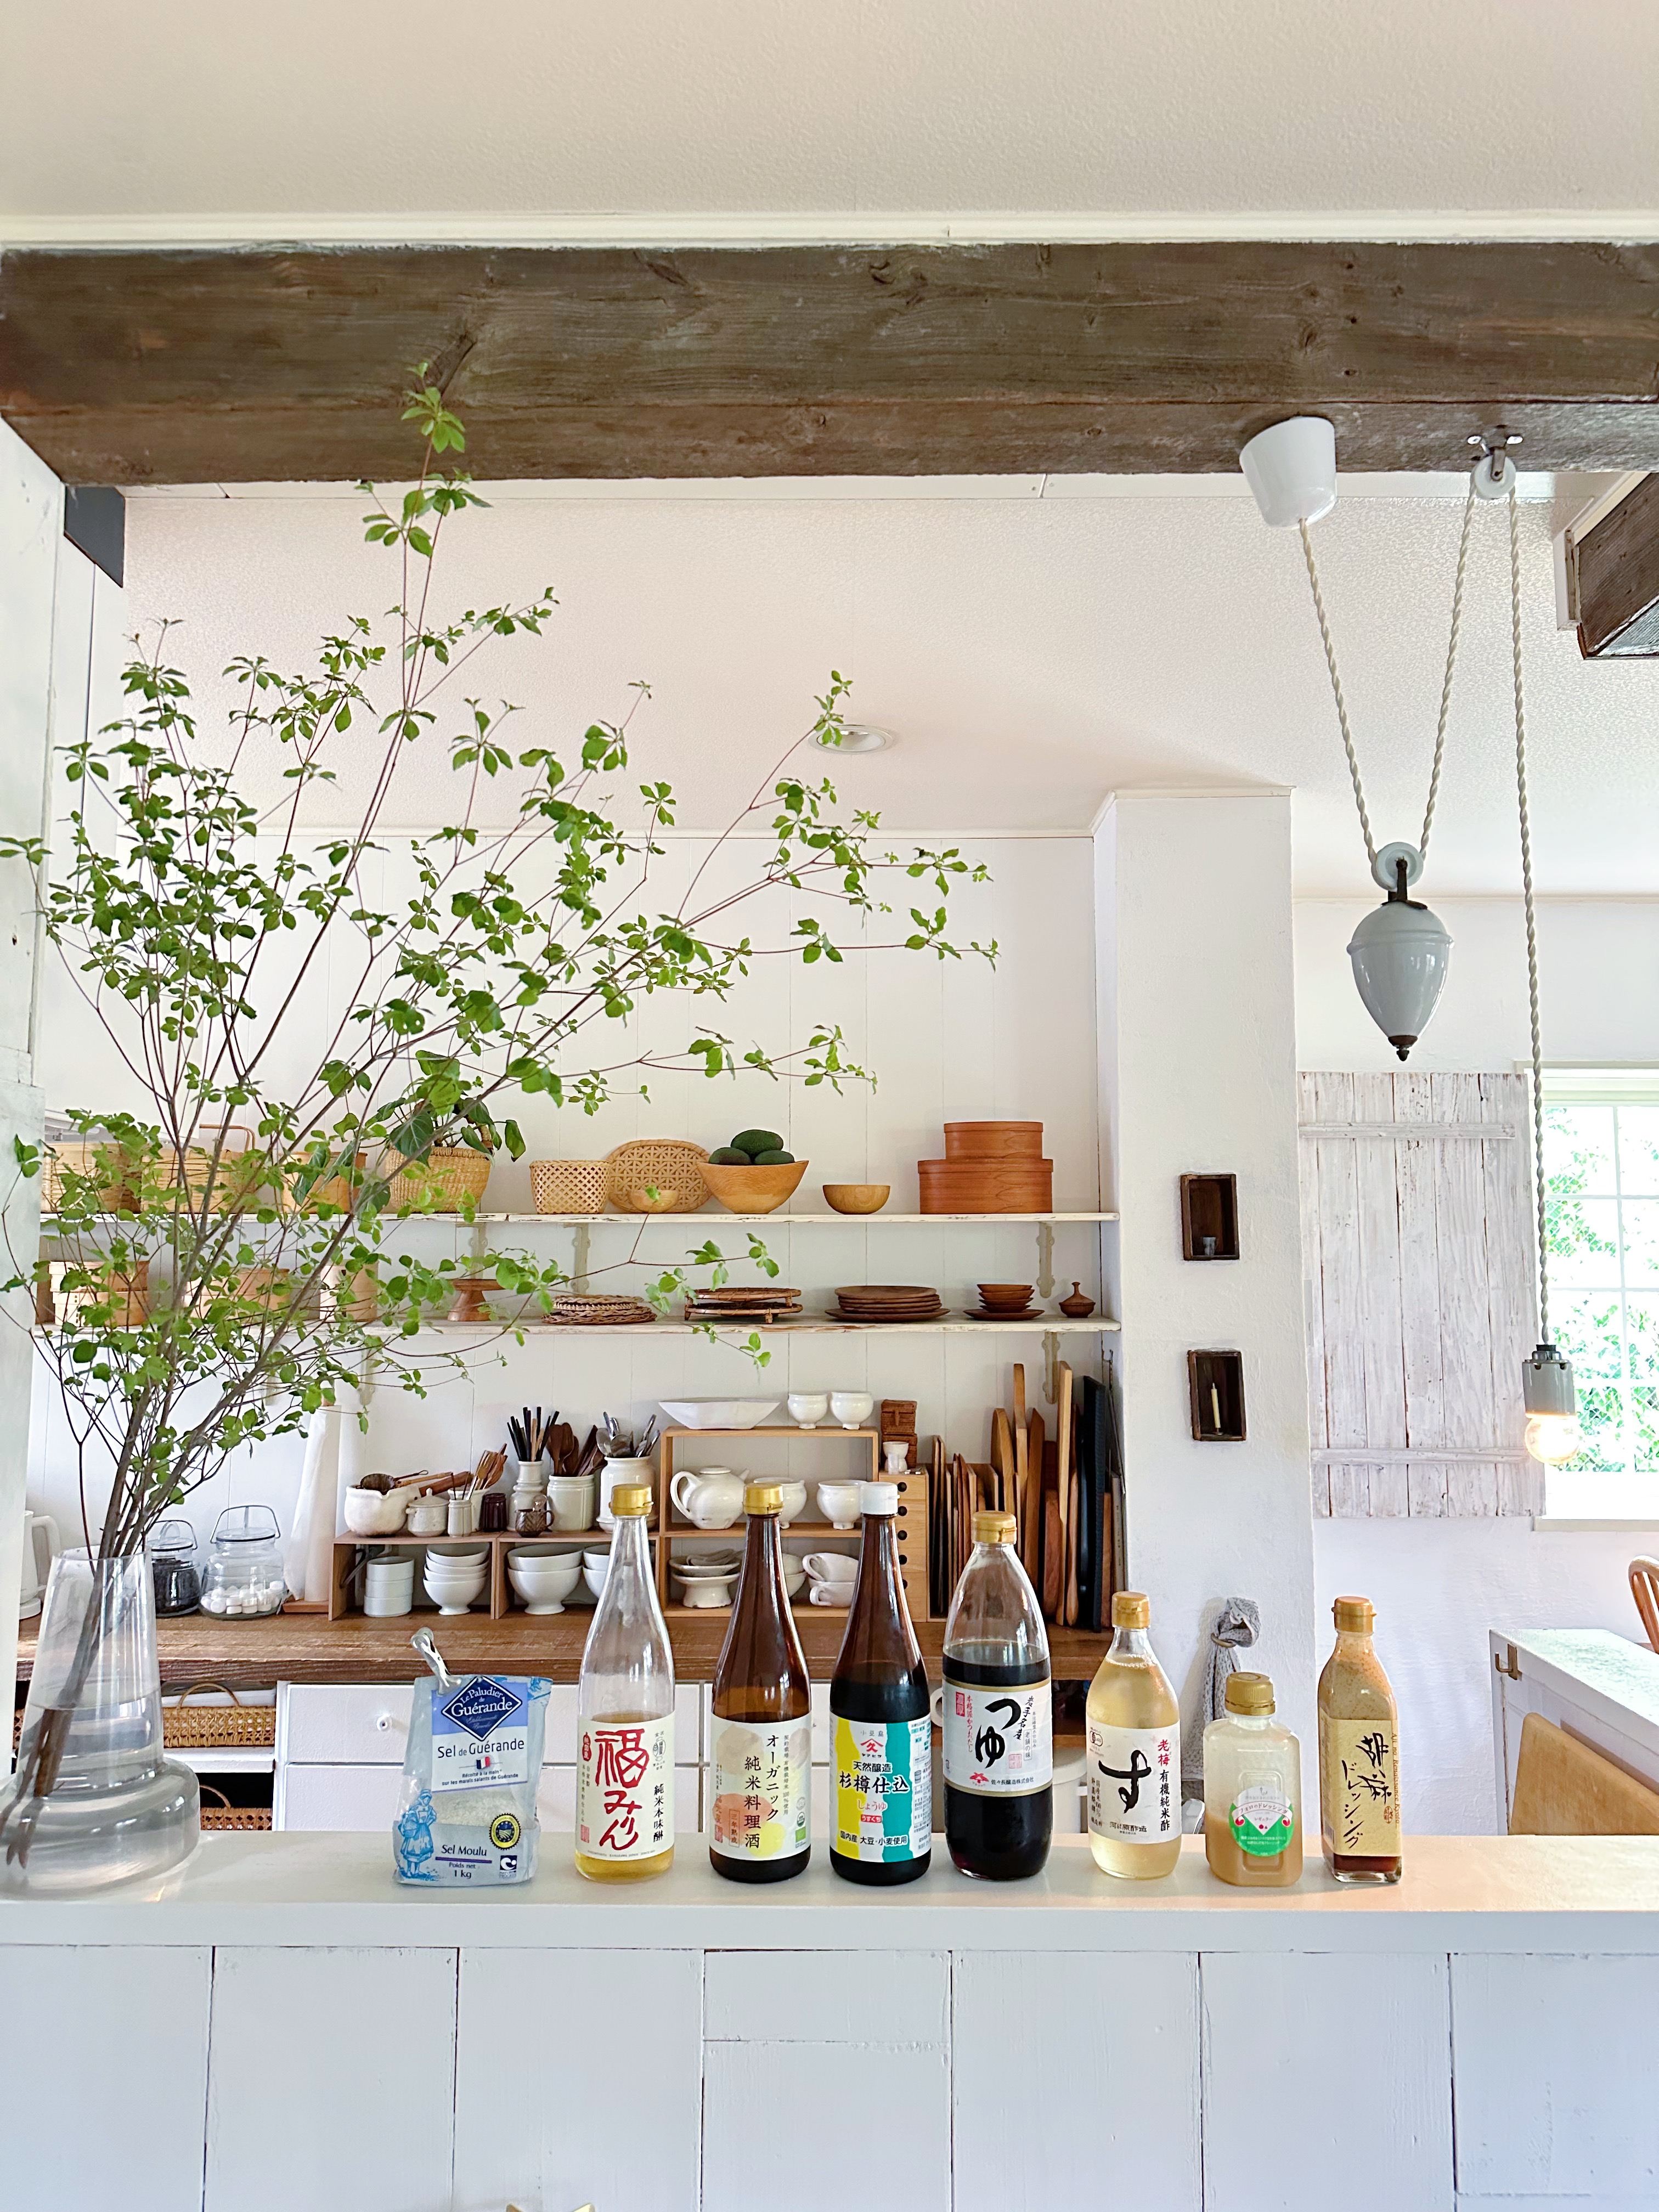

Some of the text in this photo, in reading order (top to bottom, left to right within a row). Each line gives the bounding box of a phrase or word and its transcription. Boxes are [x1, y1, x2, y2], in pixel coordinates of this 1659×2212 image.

[468, 1686, 504, 1699] Paludier
[451, 1696, 513, 1717] Guérande
[1013, 1696, 1034, 1740] 岩手名産
[975, 1698, 1021, 1769] つゆ
[438, 1745, 456, 1758] Sel
[469, 1738, 524, 1754] Guérande
[766, 1735, 781, 1821] オーガニック
[853, 1760, 891, 1773] 天然醸造
[1356, 1733, 1392, 1805] 胡麻
[839, 1771, 909, 1794] 杉樽仕込
[991, 1777, 1034, 1785] 佐々長醸造株式会社
[1098, 1750, 1152, 1813] す
[1158, 1739, 1170, 1831] 老梅 有機純米酢
[653, 1784, 664, 1842] 純米本味醂
[743, 1756, 761, 1849] 純米料理酒
[857, 1799, 887, 1812] しょうゆ
[1341, 1760, 1364, 1849] ドレッシング
[840, 1830, 858, 1843] 国内産
[441, 1844, 487, 1856] Sel Moulu
[460, 1870, 472, 1880] kg
